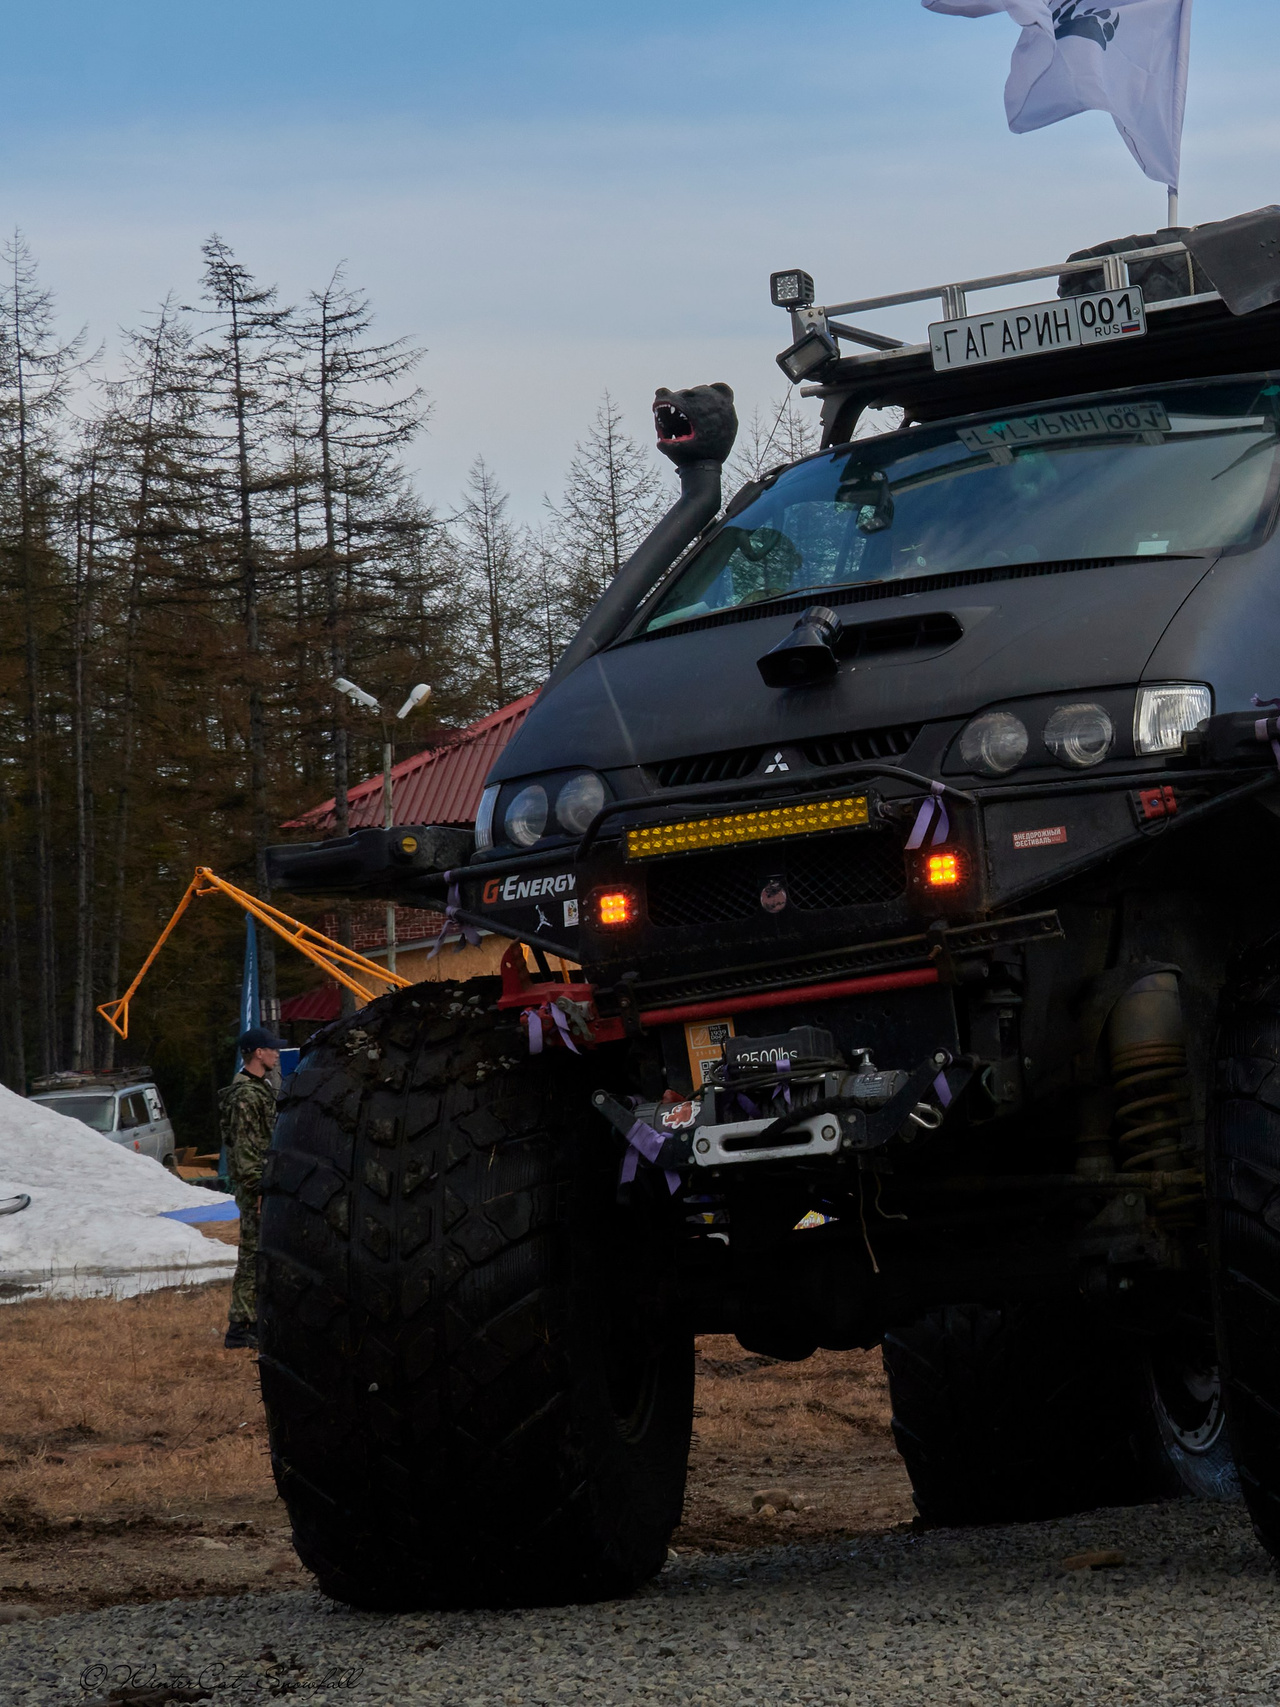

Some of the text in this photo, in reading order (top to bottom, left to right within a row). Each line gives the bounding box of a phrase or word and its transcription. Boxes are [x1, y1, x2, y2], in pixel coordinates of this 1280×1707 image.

[943, 293, 1133, 363] ГАГАРИН 001
[1094, 323, 1121, 338] RUS
[1013, 827, 1061, 841] ВНЕДОРОЖНЫЙ
[1014, 837, 1052, 848] ФЕСТИВАЛЬ
